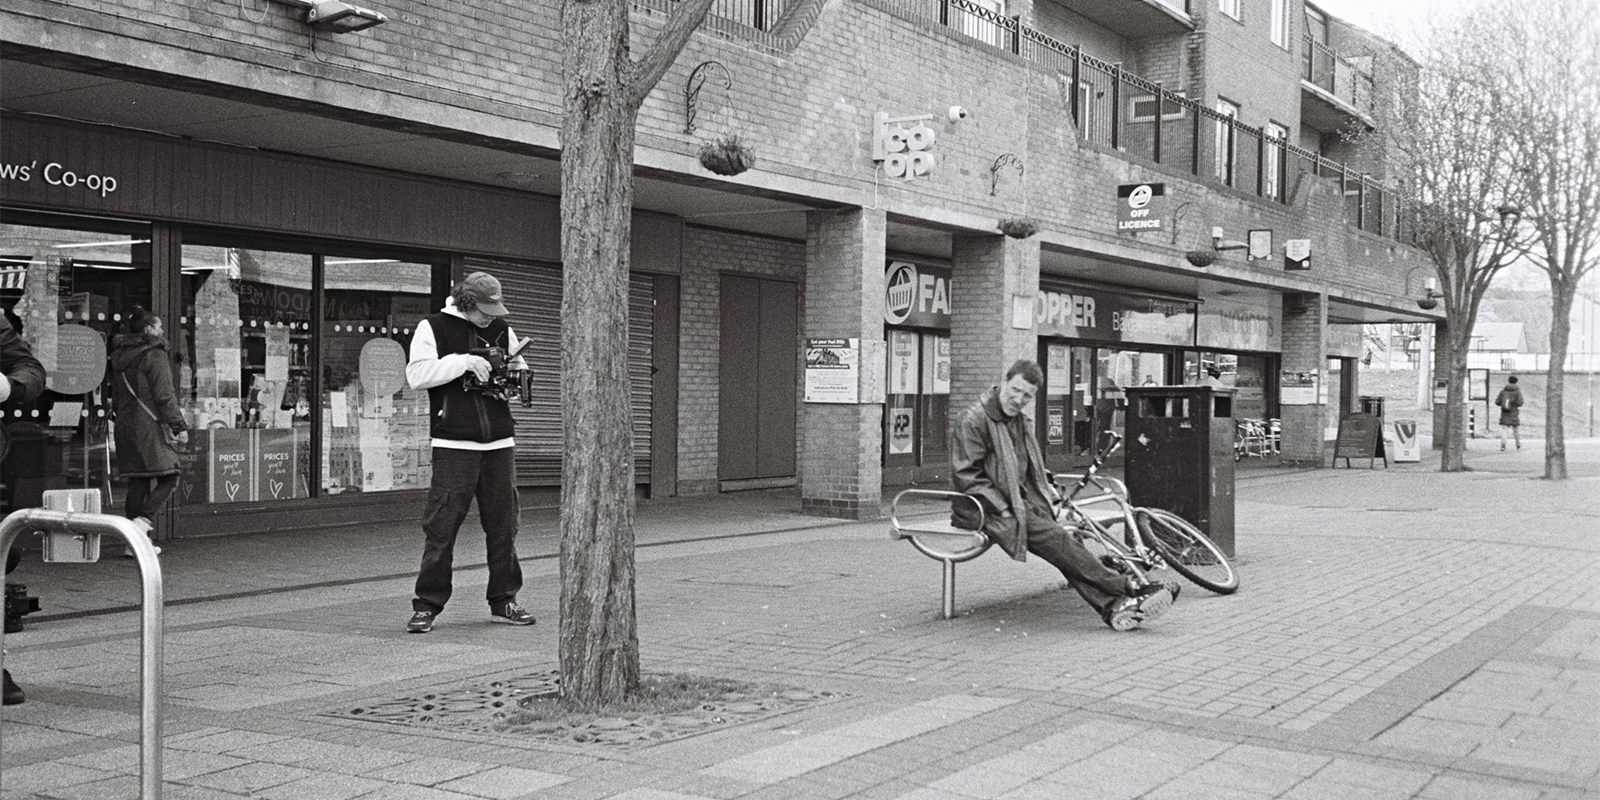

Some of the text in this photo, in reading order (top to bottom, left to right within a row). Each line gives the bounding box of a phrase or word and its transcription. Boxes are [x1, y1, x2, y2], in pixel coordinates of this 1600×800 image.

[43, 162, 117, 198] Co-op
[1130, 208, 1150, 218] OFF
[1118, 219, 1161, 230] LICENCE
[918, 273, 952, 315] FA
[1049, 414, 1063, 426] FREE
[1048, 426, 1063, 437] ATM
[219, 453, 245, 461] PRICES
[263, 452, 289, 461] PRICES
